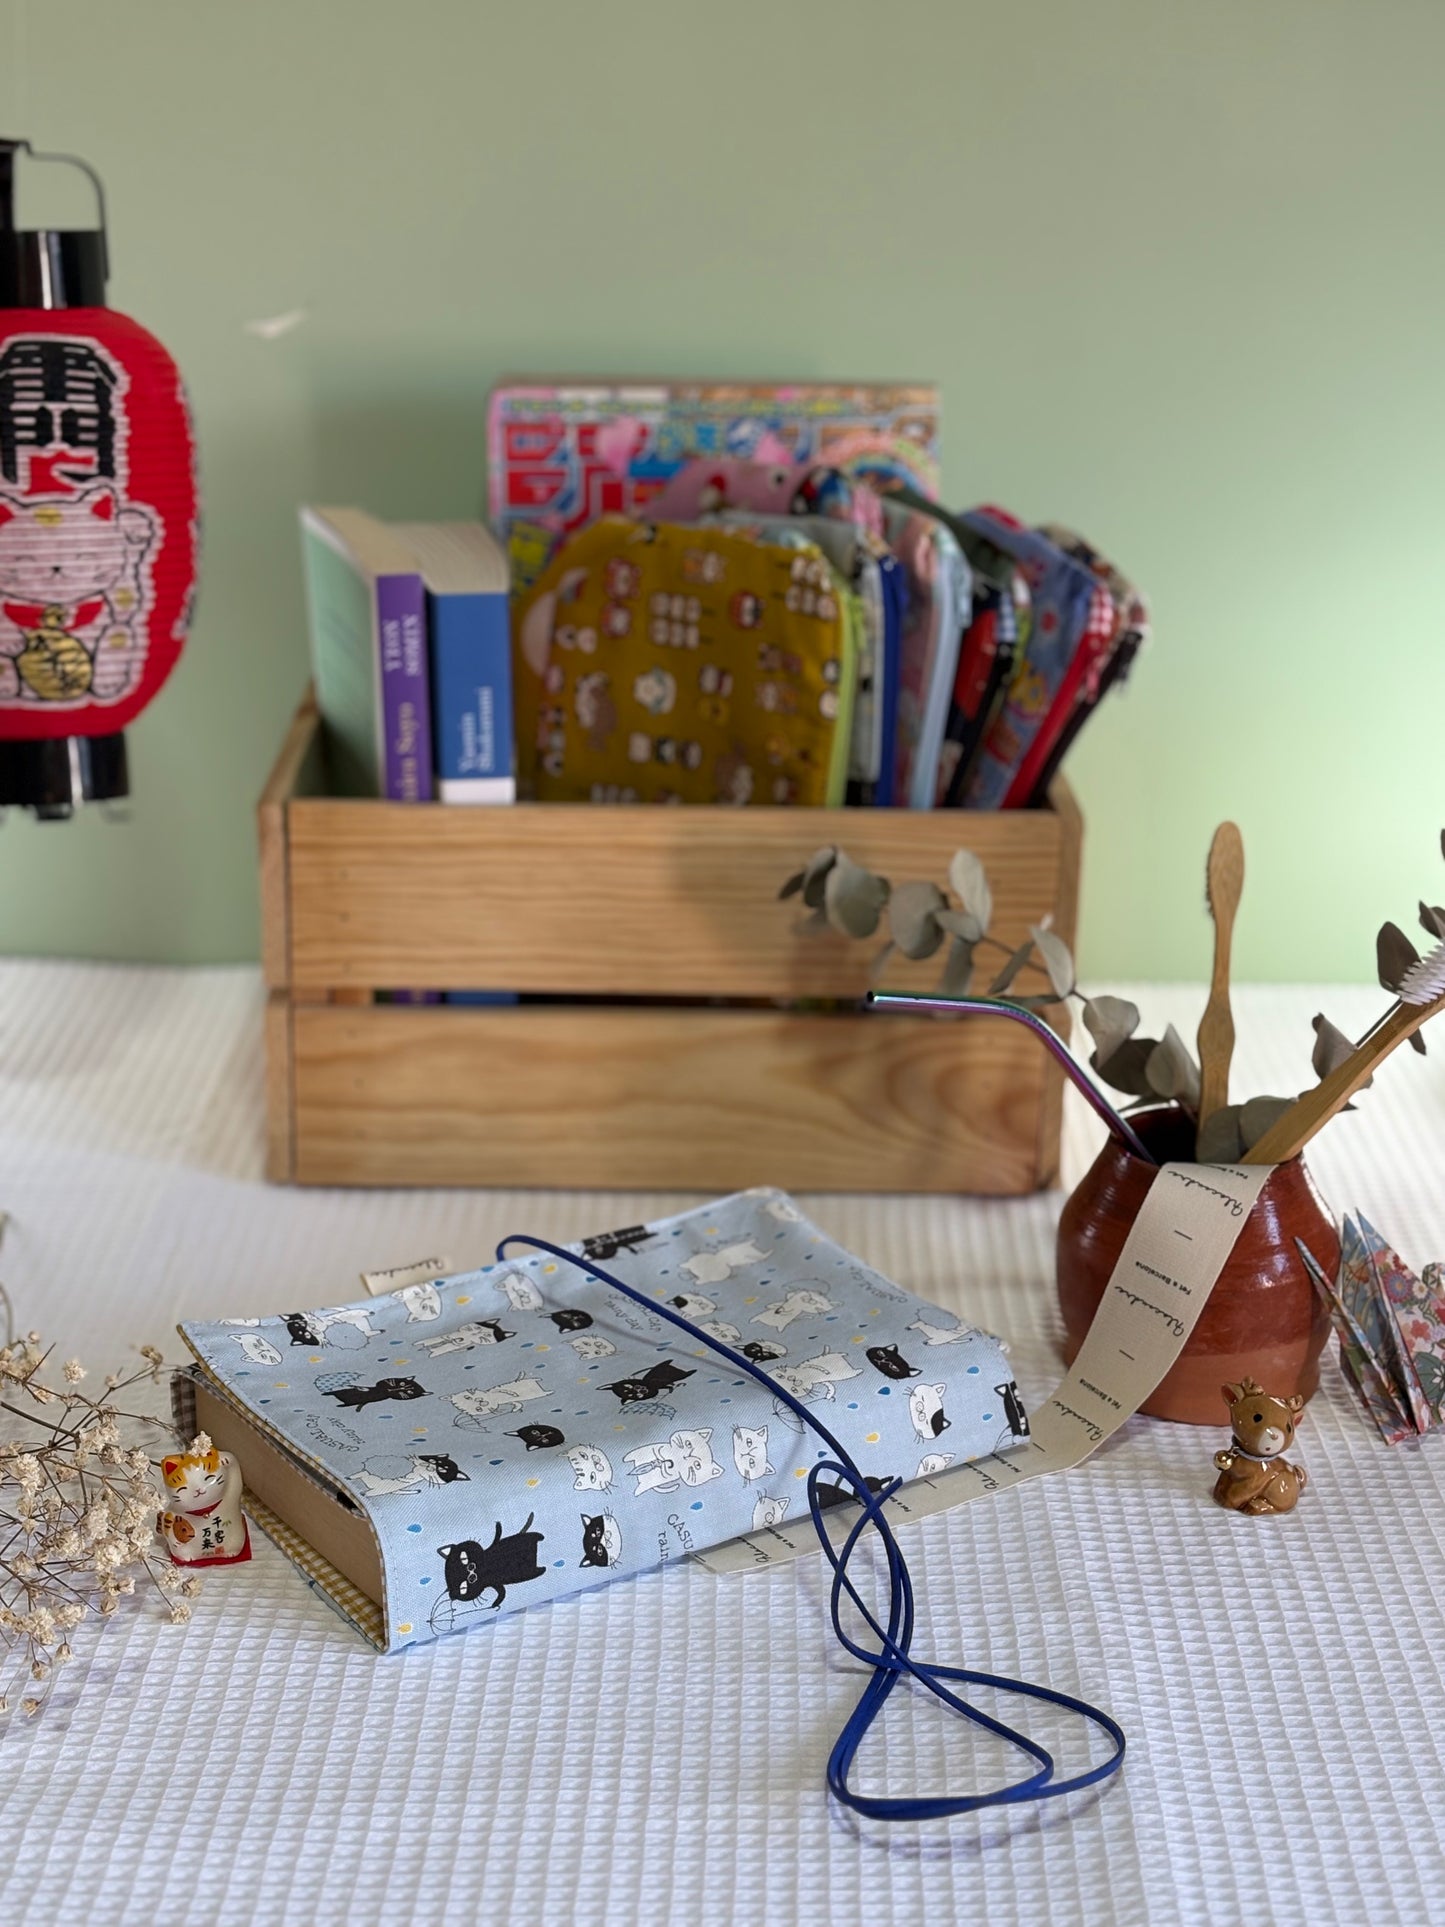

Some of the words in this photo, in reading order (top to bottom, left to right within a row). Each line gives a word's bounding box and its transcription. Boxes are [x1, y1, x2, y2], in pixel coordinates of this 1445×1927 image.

[1135, 1261, 1172, 1285] Barcelona
[1179, 1284, 1192, 1296] Fet
[1079, 1378, 1108, 1401] Barcelona
[1111, 1400, 1122, 1410] Fet
[667, 1513, 694, 1554] CASU
